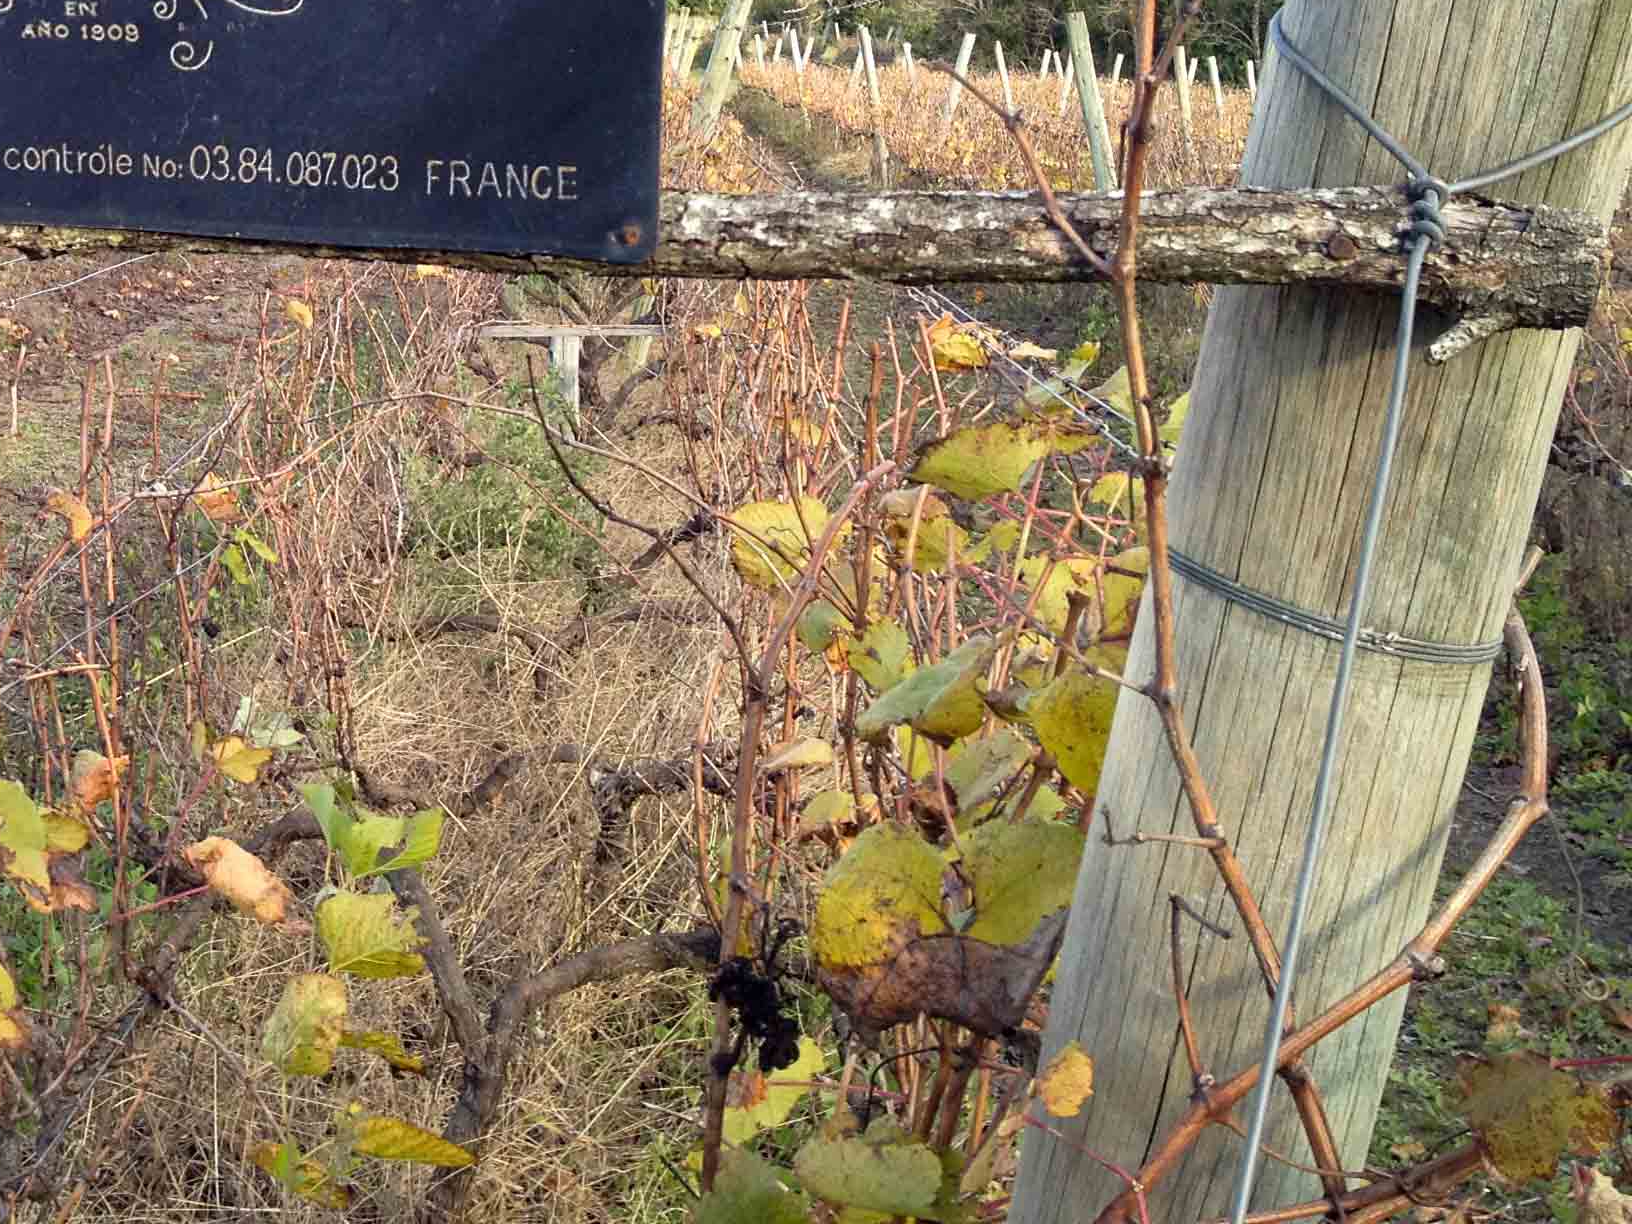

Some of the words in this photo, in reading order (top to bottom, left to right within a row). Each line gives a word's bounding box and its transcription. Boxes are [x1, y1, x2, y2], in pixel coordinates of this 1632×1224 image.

[64, 0, 98, 17] EN
[21, 19, 70, 39] AÑO
[80, 23, 140, 43] 1909
[426, 159, 577, 201] FRANCE
